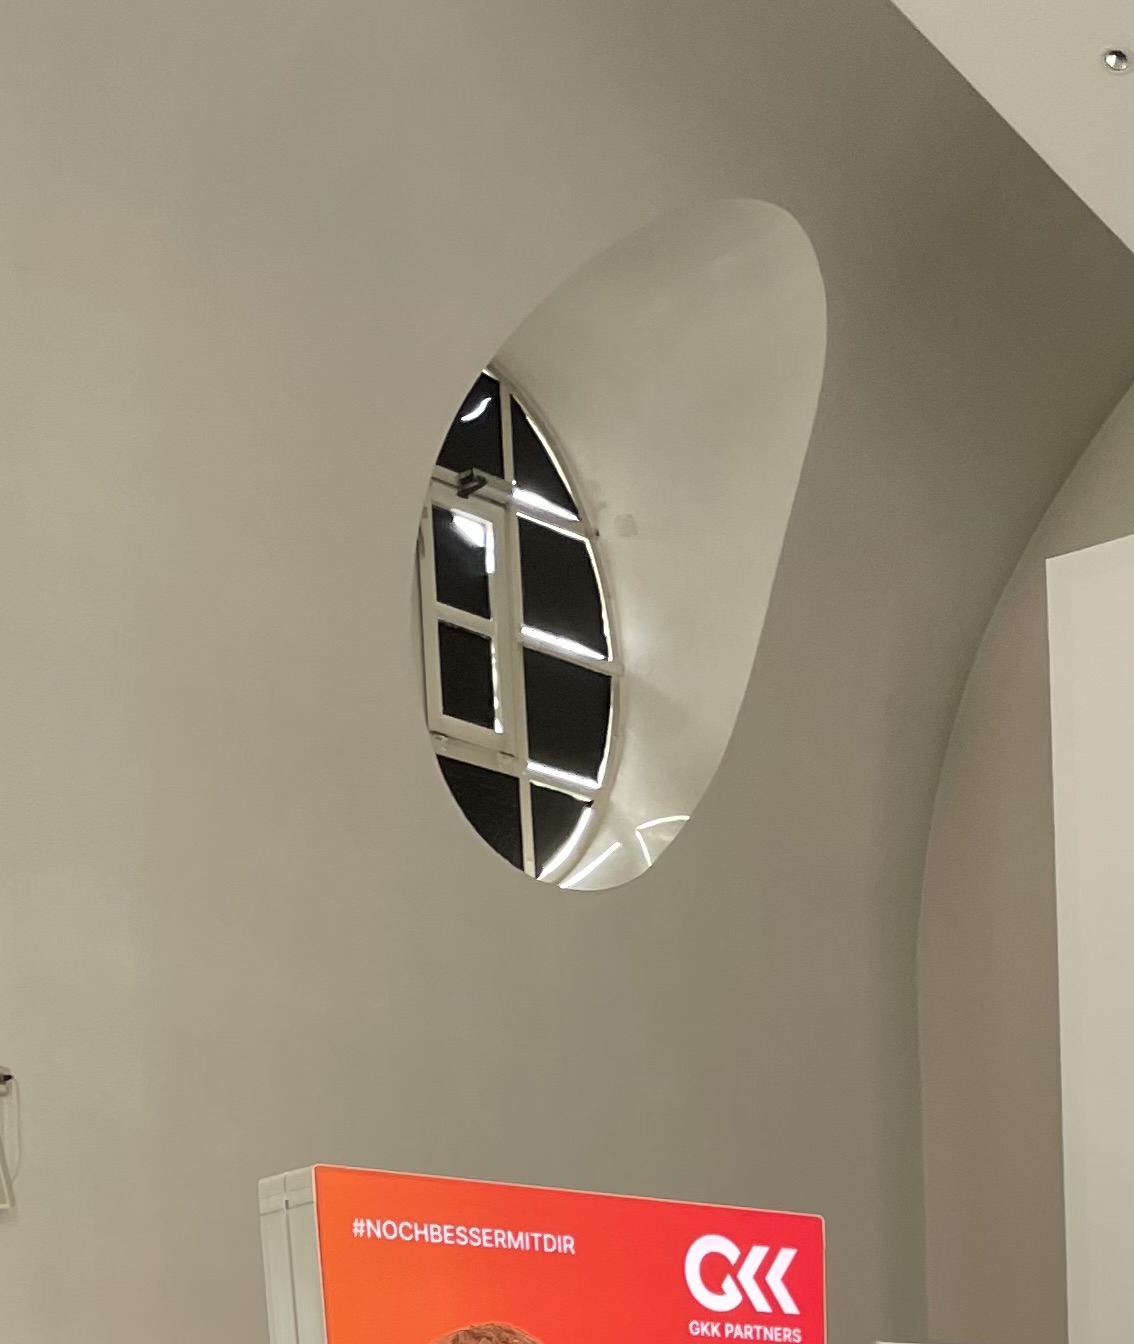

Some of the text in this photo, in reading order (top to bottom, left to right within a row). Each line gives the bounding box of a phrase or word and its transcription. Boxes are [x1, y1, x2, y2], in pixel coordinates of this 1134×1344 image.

[352, 1218, 576, 1255] #NOCHBESSERMITDIR
[688, 1320, 802, 1344] GKK PARTNERS
